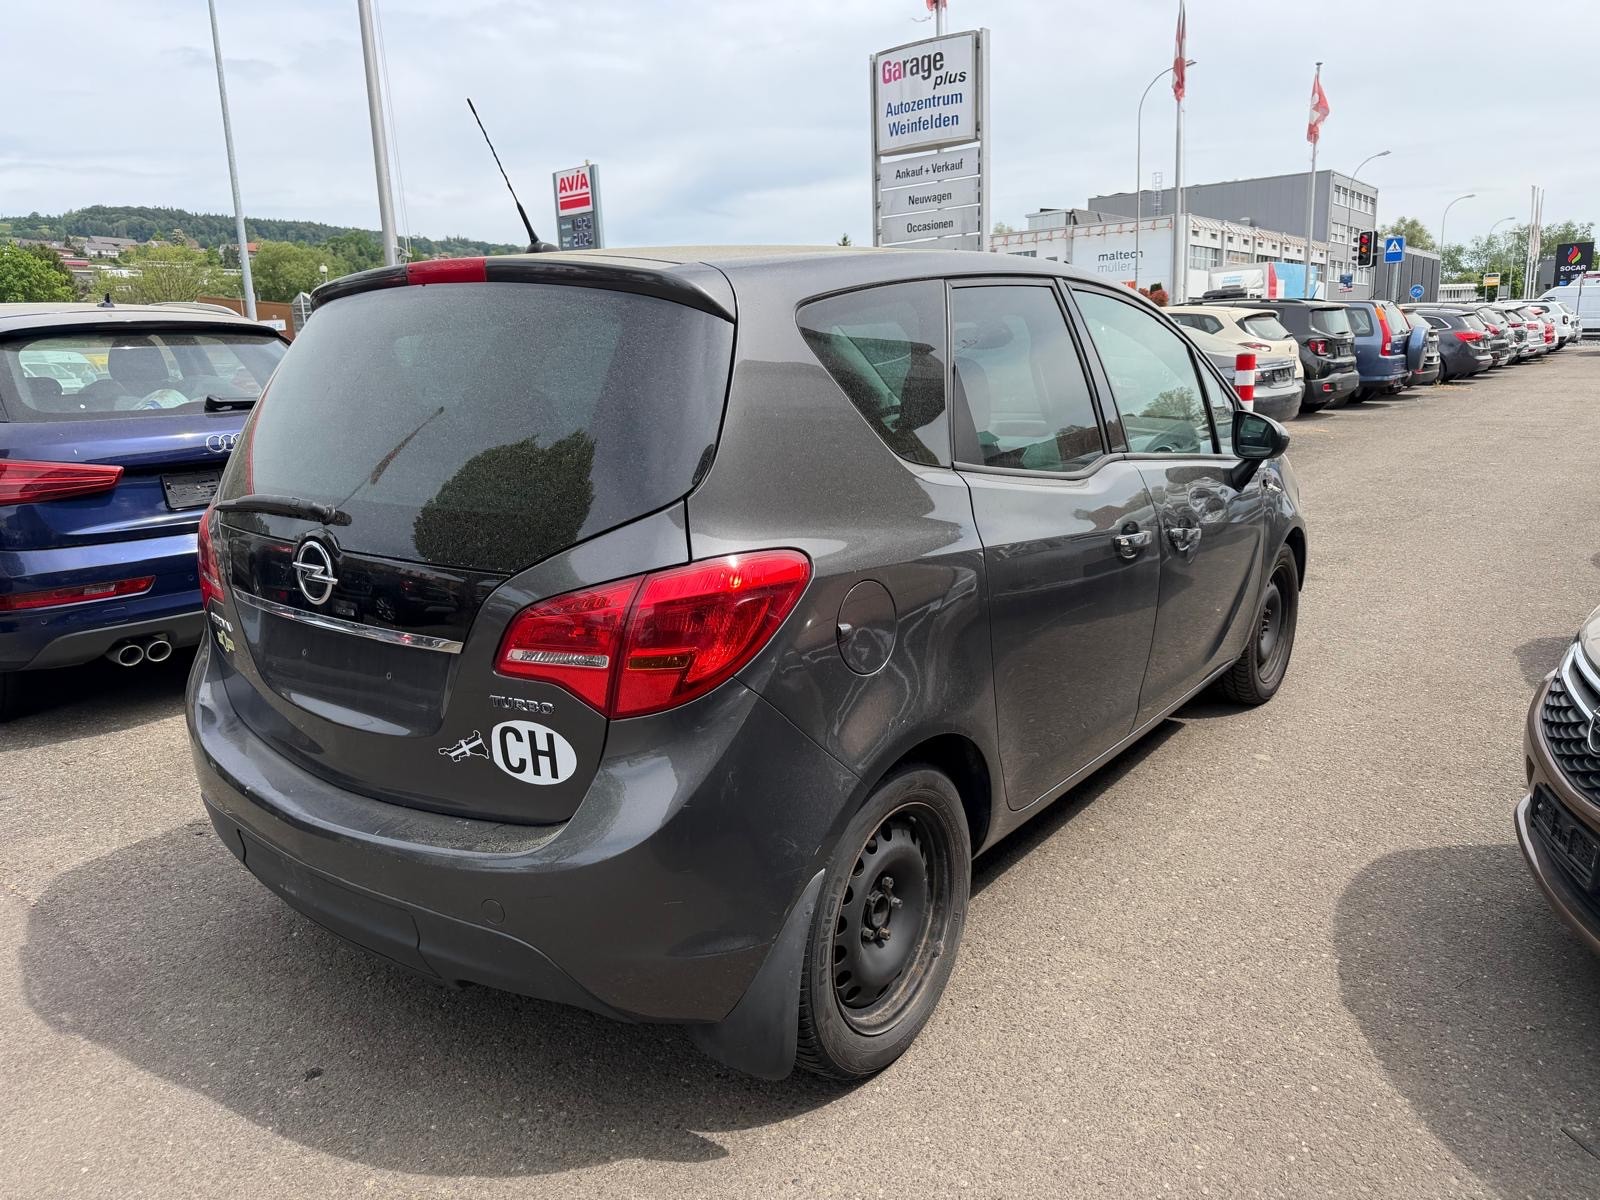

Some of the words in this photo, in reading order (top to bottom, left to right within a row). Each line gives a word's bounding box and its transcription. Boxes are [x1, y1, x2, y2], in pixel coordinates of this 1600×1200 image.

[882, 51, 944, 84] Garage
[933, 69, 967, 90] plus
[886, 92, 963, 118] Autozentrum
[888, 112, 959, 137] Weinfelden
[895, 163, 923, 180] Ankauf
[931, 158, 963, 175] Verkauf
[908, 191, 952, 206] Neuwagen
[906, 219, 954, 234] Occasionen
[1098, 250, 1144, 262] maltech
[1560, 264, 1587, 272] SOCAR
[489, 694, 555, 715] TURBO
[499, 725, 559, 780] CH
